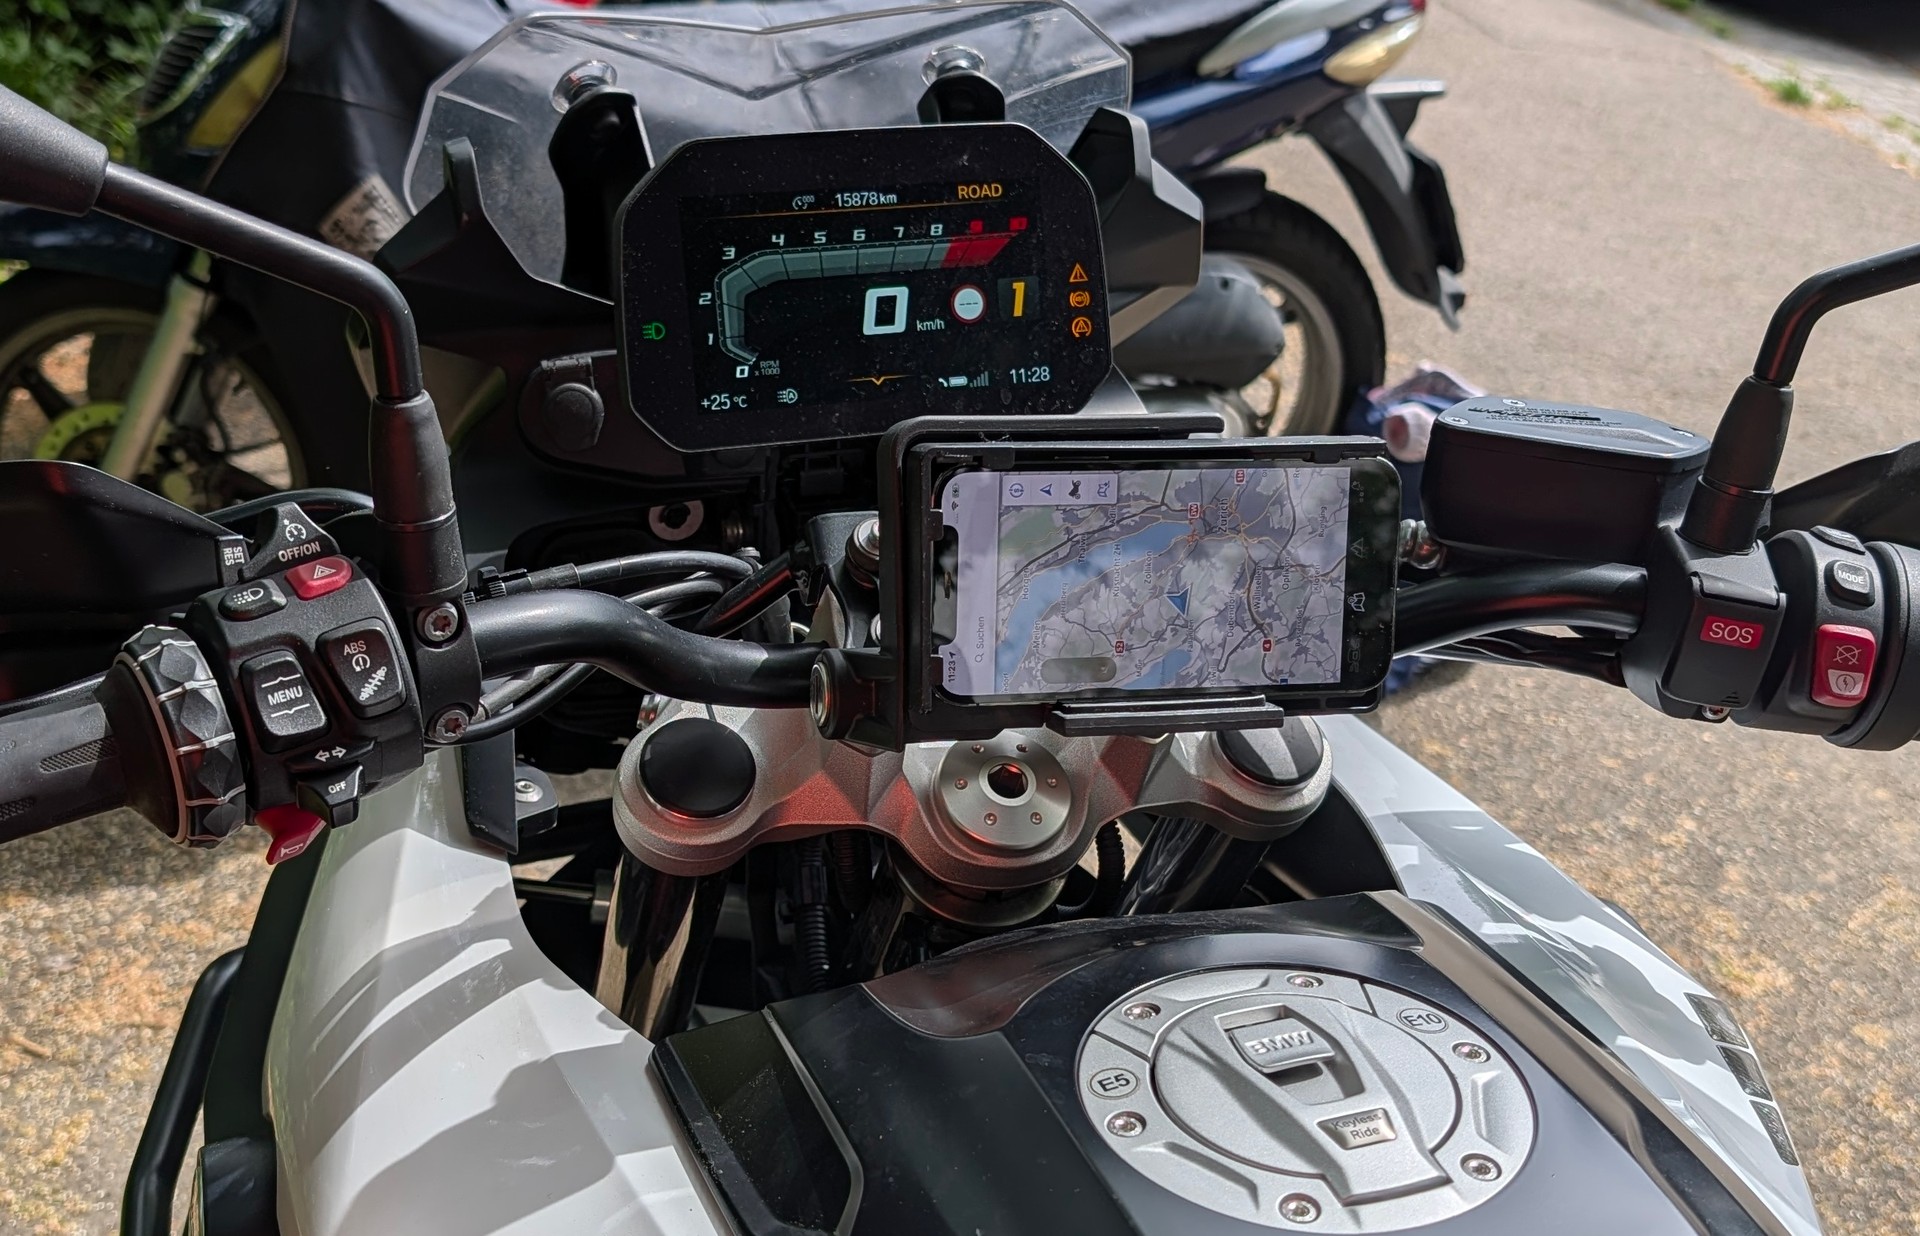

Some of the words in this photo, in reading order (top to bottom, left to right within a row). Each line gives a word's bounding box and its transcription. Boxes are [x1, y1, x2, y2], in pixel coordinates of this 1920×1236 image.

[957, 183, 1002, 199] ROAD
[813, 231, 827, 244] 5
[853, 229, 866, 241] 6
[893, 226, 904, 238] 7
[930, 224, 943, 236] 8
[771, 234, 785, 246] 4
[722, 247, 735, 260] 3
[699, 292, 712, 305] 2
[1012, 281, 1025, 317] 1
[863, 286, 909, 336] 0
[916, 318, 945, 331] km/h
[707, 333, 714, 346] 1
[736, 365, 749, 378] 0
[760, 360, 780, 369] RPM
[761, 367, 781, 376] 1000
[1010, 366, 1051, 384] 11:28
[701, 393, 731, 411] +25
[223, 547, 235, 566] RES
[233, 546, 245, 564] SET
[278, 541, 321, 562] OFF/ON
[1144, 550, 1152, 584] Zollikon
[1282, 556, 1290, 590] Opfikon
[1022, 567, 1031, 600] Horgen
[1837, 569, 1865, 585] MODE
[1254, 565, 1262, 611] Wallisellen
[976, 616, 984, 649] Suchen
[1033, 620, 1041, 649] Meilen
[1709, 622, 1754, 644] SOS
[343, 640, 367, 656] ABS
[948, 660, 956, 683] 11:23
[267, 685, 303, 706] MENU
[328, 780, 347, 794] OFF
[1402, 1013, 1442, 1026] E10
[1244, 1030, 1315, 1054] BMW
[1097, 1073, 1130, 1092] E5
[1331, 1112, 1382, 1131] Keyless
[1350, 1126, 1380, 1141] Ride
